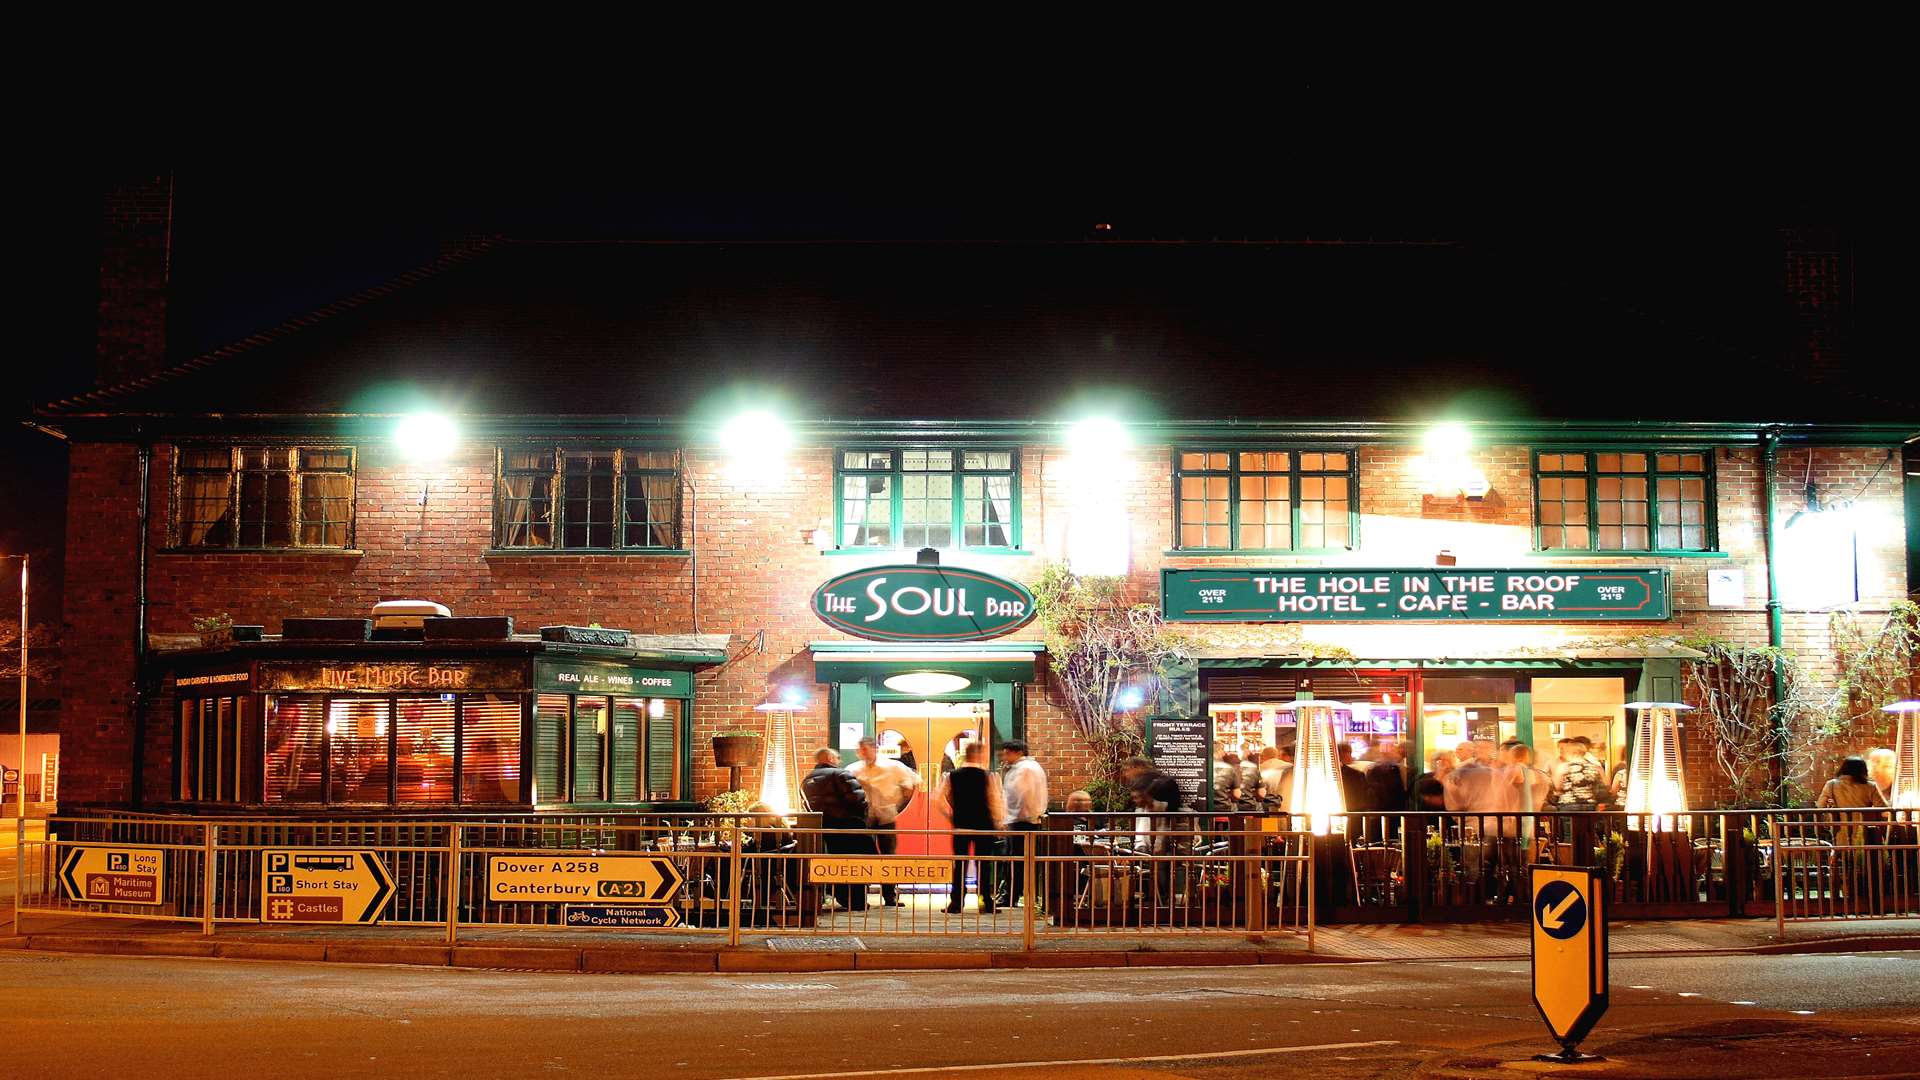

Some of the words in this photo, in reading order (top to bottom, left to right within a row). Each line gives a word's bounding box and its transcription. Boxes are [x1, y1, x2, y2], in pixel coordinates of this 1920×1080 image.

[1253, 577, 1306, 593] THE
[1319, 577, 1390, 593] HOLE
[1403, 576, 1429, 592] IN
[1442, 576, 1495, 592] THE
[1507, 576, 1580, 592] ROOF
[1199, 589, 1227, 597] OVER
[1597, 586, 1625, 594] OVER
[823, 592, 857, 613] THE
[864, 577, 975, 622] SOUL
[985, 597, 1025, 617] BAR
[1279, 595, 1366, 612] HOTEL
[1399, 595, 1467, 611] CAFE
[1502, 595, 1555, 611] BAR
[322, 667, 356, 685] LIVE
[365, 667, 420, 685] MUSIC
[428, 667, 465, 685] BAR
[559, 673, 580, 682] REAL
[584, 675, 599, 683] ALE
[608, 676, 633, 685] WINES
[642, 678, 672, 686] COFFEE
[134, 854, 157, 863] Long
[137, 864, 157, 874] Stay
[497, 862, 544, 873] Dover
[552, 862, 599, 873] A258
[813, 864, 873, 877] QUEEN
[881, 865, 949, 878] STREET
[113, 877, 152, 887] Maritime
[296, 880, 328, 889] Short
[333, 880, 359, 890] Stay
[114, 888, 151, 898] Museum
[496, 882, 591, 896] Canterbury
[599, 882, 644, 896] (A2)
[297, 903, 338, 913] Castles
[606, 909, 646, 917] National
[591, 918, 617, 926] Cycle
[621, 917, 662, 925] Network
